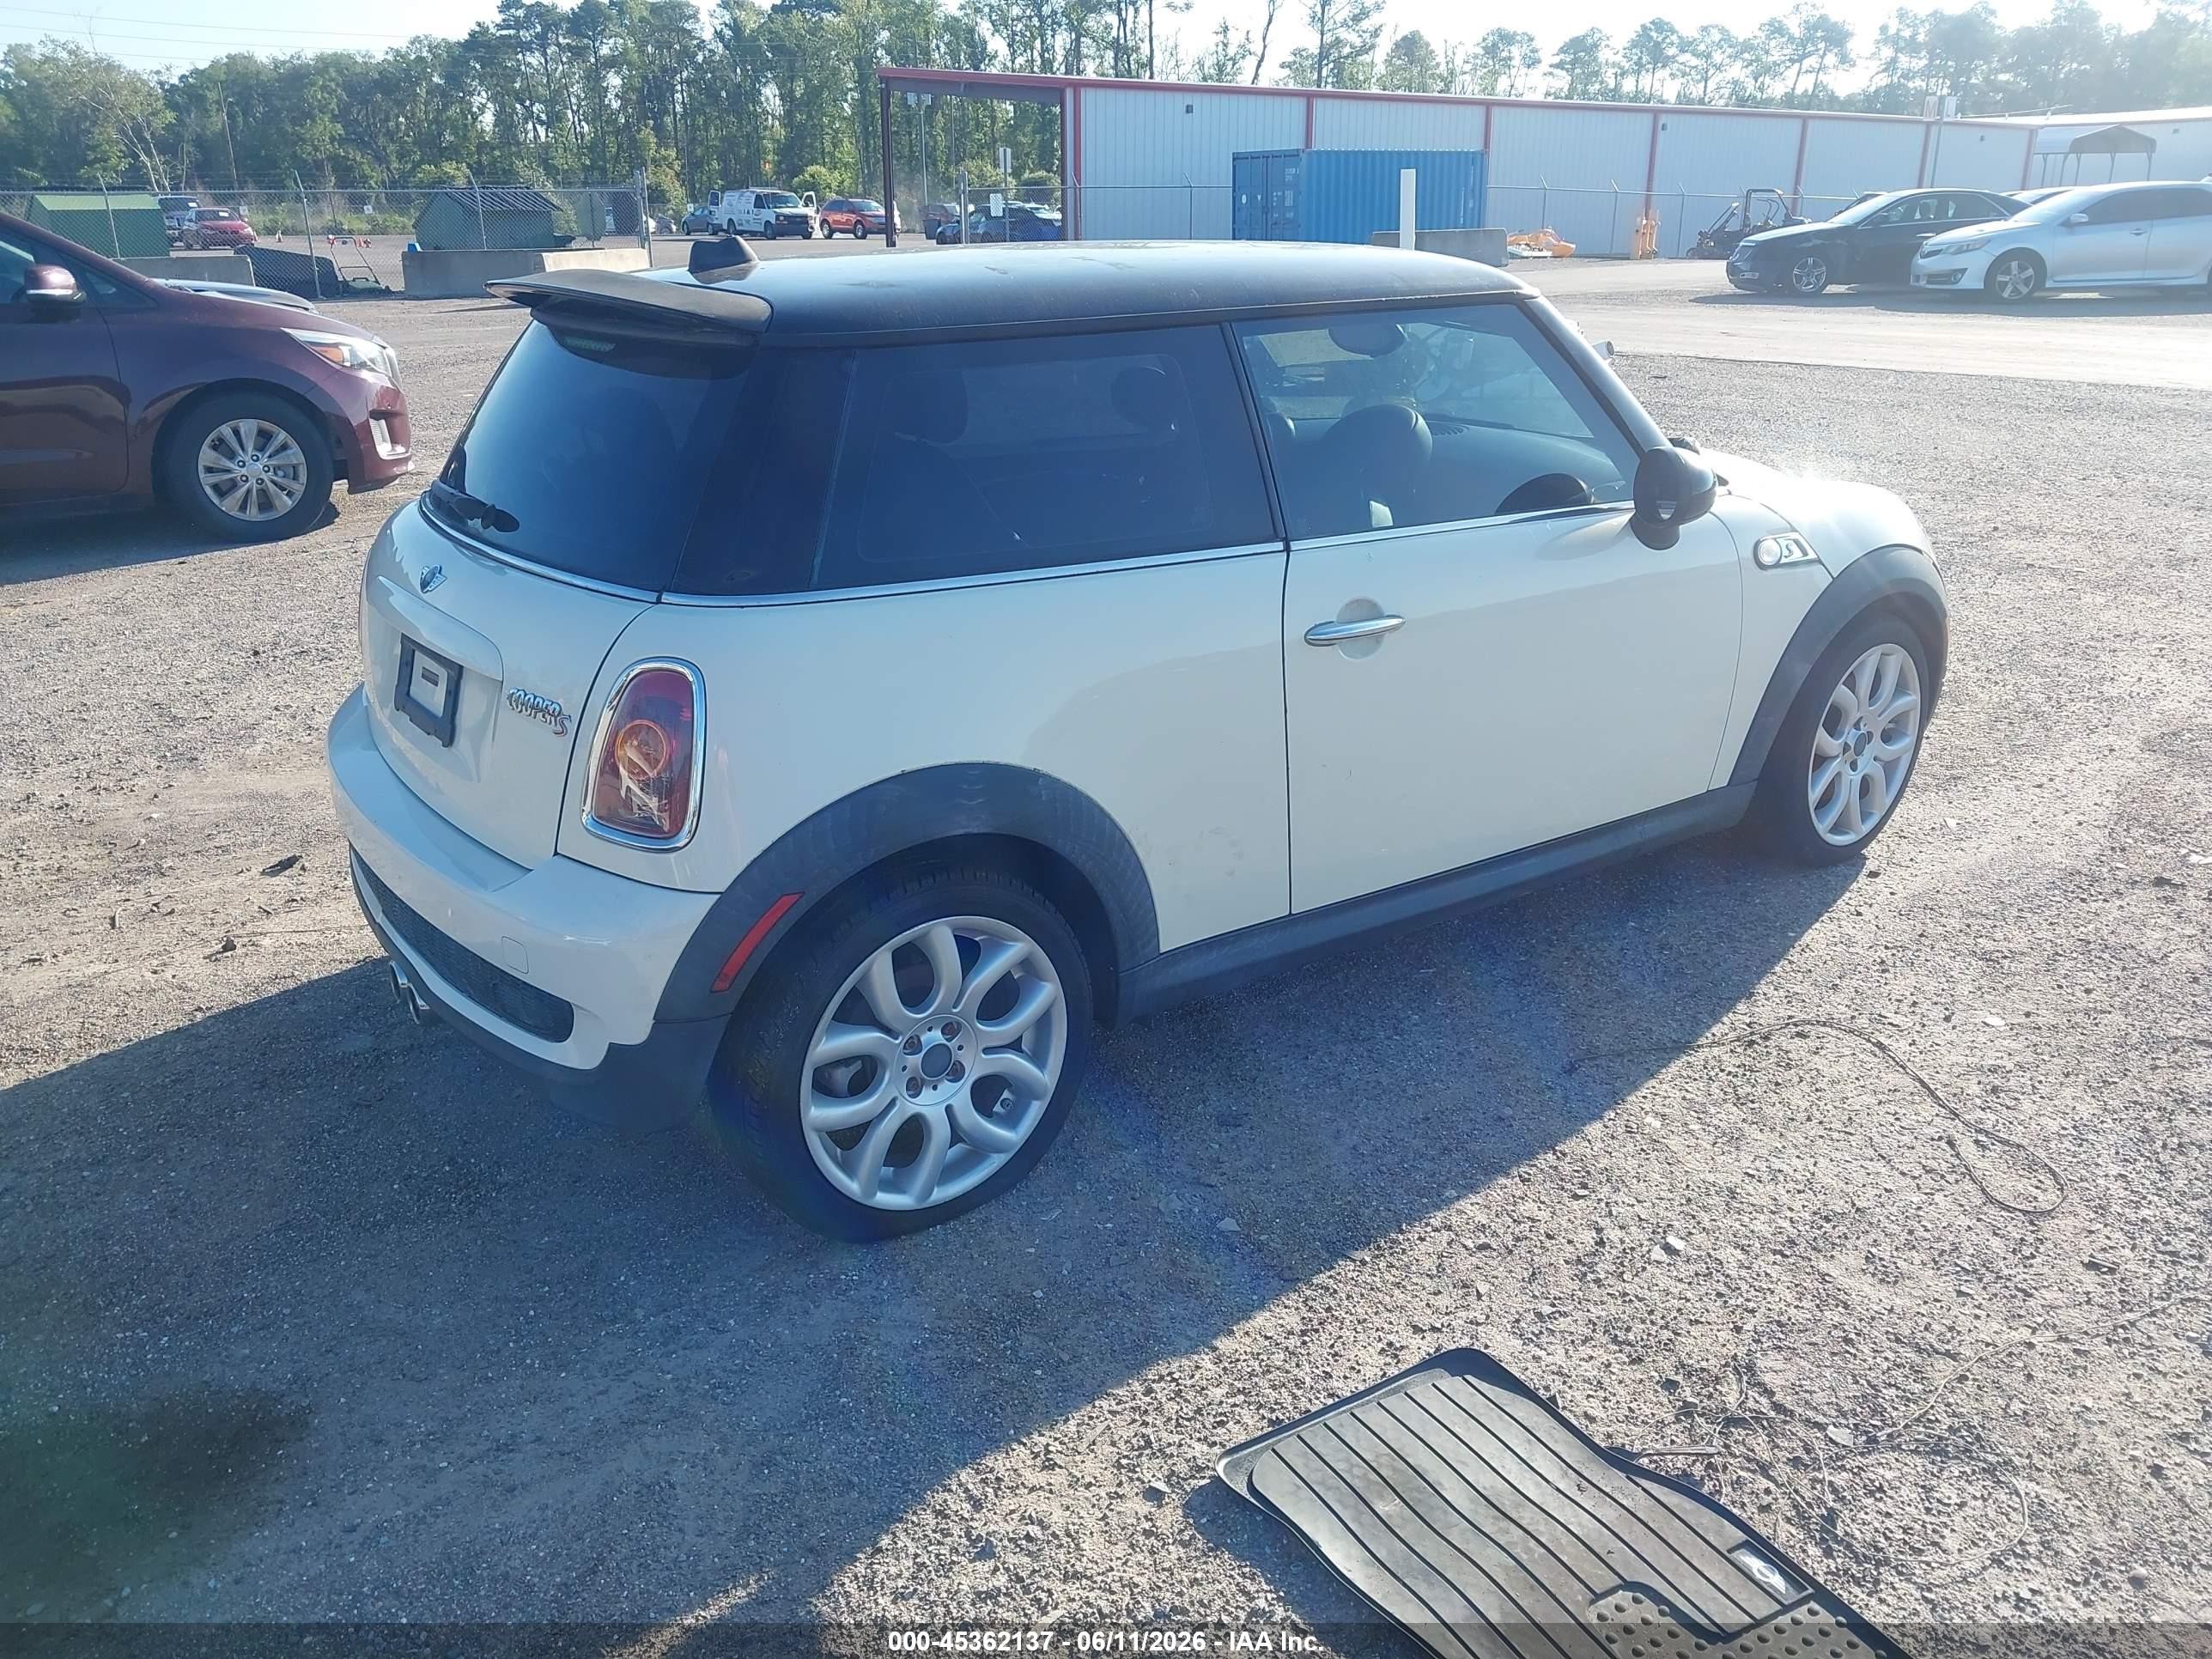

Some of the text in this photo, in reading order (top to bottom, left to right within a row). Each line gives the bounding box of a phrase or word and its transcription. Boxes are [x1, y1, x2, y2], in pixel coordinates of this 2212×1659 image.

[1925, 100, 1937, 118] M
[507, 688, 572, 737] COOPER S
